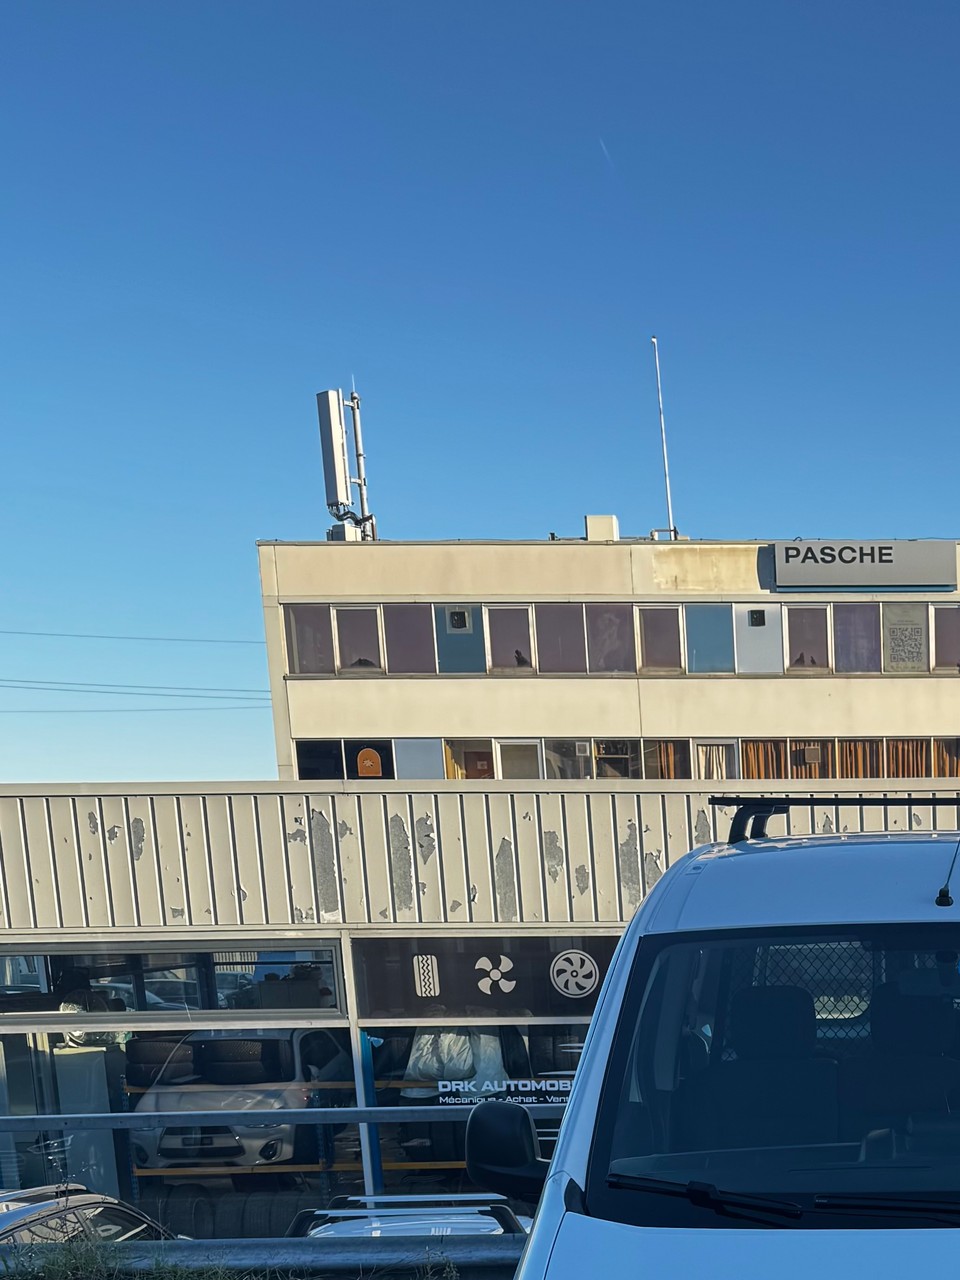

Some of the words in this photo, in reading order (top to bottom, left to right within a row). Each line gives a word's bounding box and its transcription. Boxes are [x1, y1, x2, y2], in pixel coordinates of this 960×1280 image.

[784, 546, 894, 564] PASCHE
[438, 1080, 477, 1092] DRK
[506, 1095, 538, 1103] Achat
